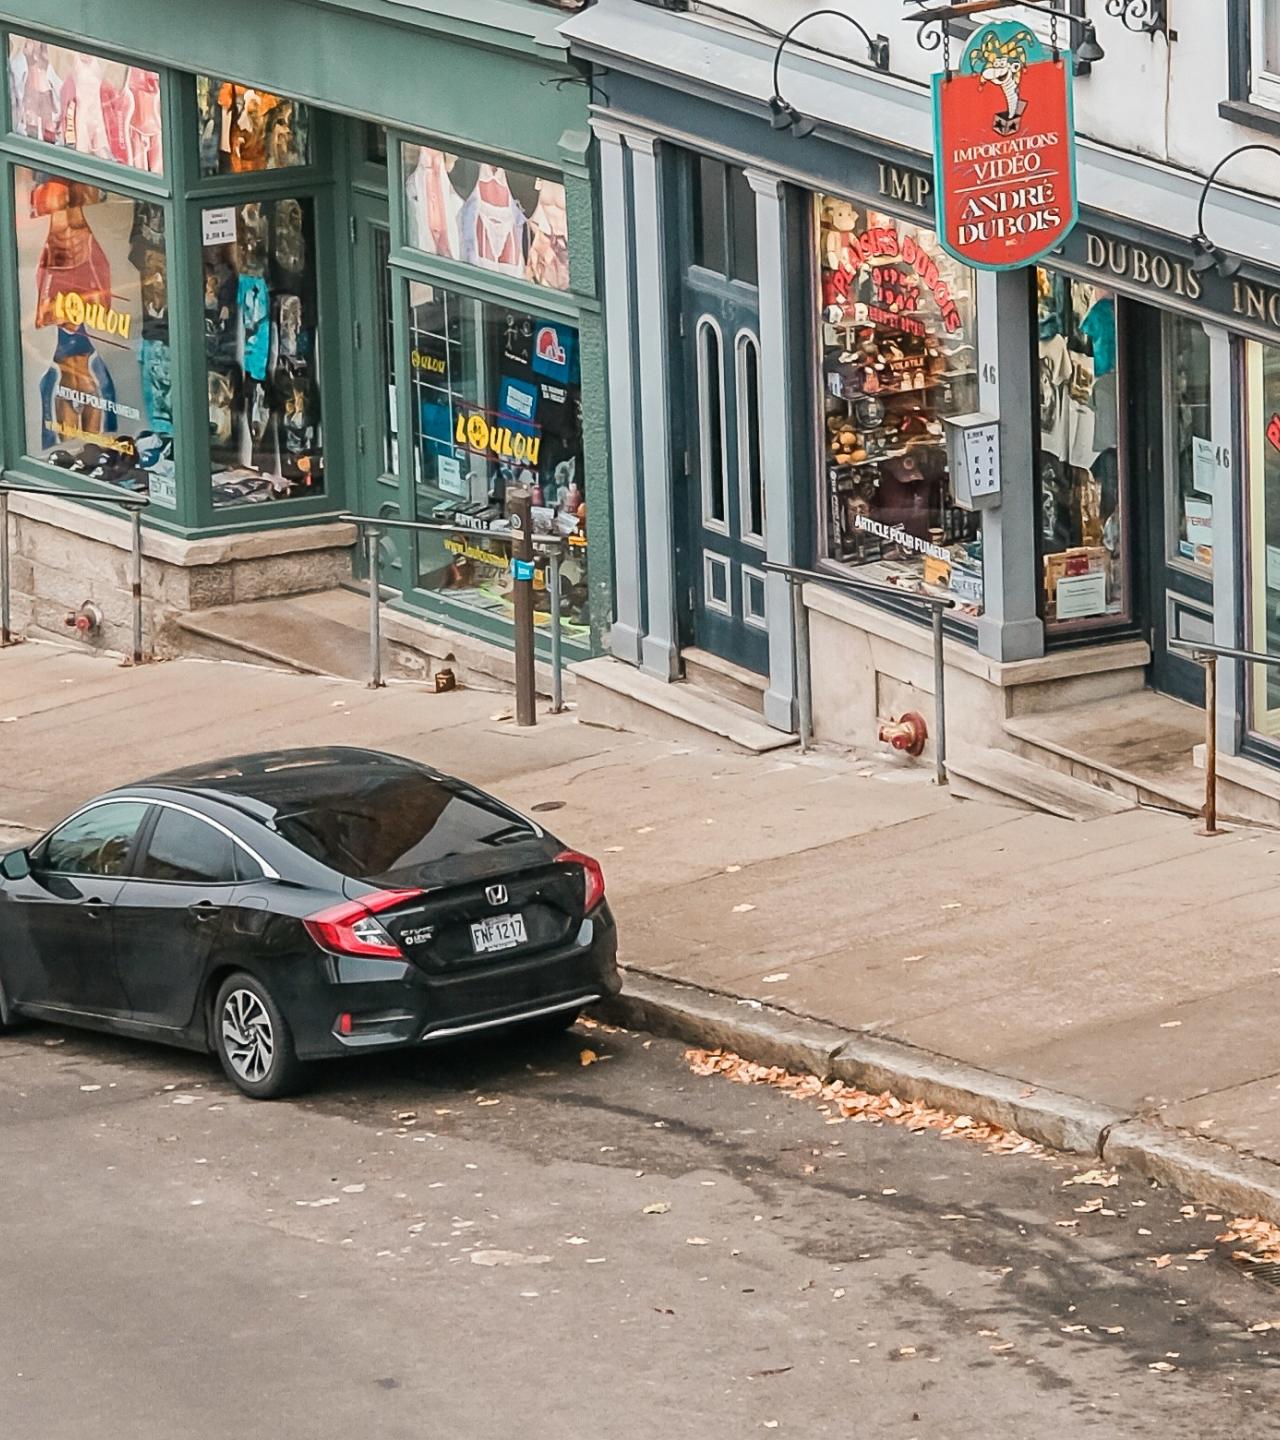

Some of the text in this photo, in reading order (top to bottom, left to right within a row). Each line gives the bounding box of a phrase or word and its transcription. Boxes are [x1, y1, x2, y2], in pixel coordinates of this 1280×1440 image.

[953, 132, 1059, 163] IMPORTATIONS
[973, 151, 1041, 183] VIDÉO
[961, 179, 1056, 220] ANDRÉ
[957, 208, 1061, 246] DUBOIS
[1086, 232, 1202, 299] DUBOIS
[55, 290, 132, 340] LOULOU
[455, 413, 541, 466] LOULOU
[1215, 445, 1230, 469] 46
[974, 455, 982, 487] EAU
[854, 514, 952, 563] ARTICLE POUR FUMEUR
